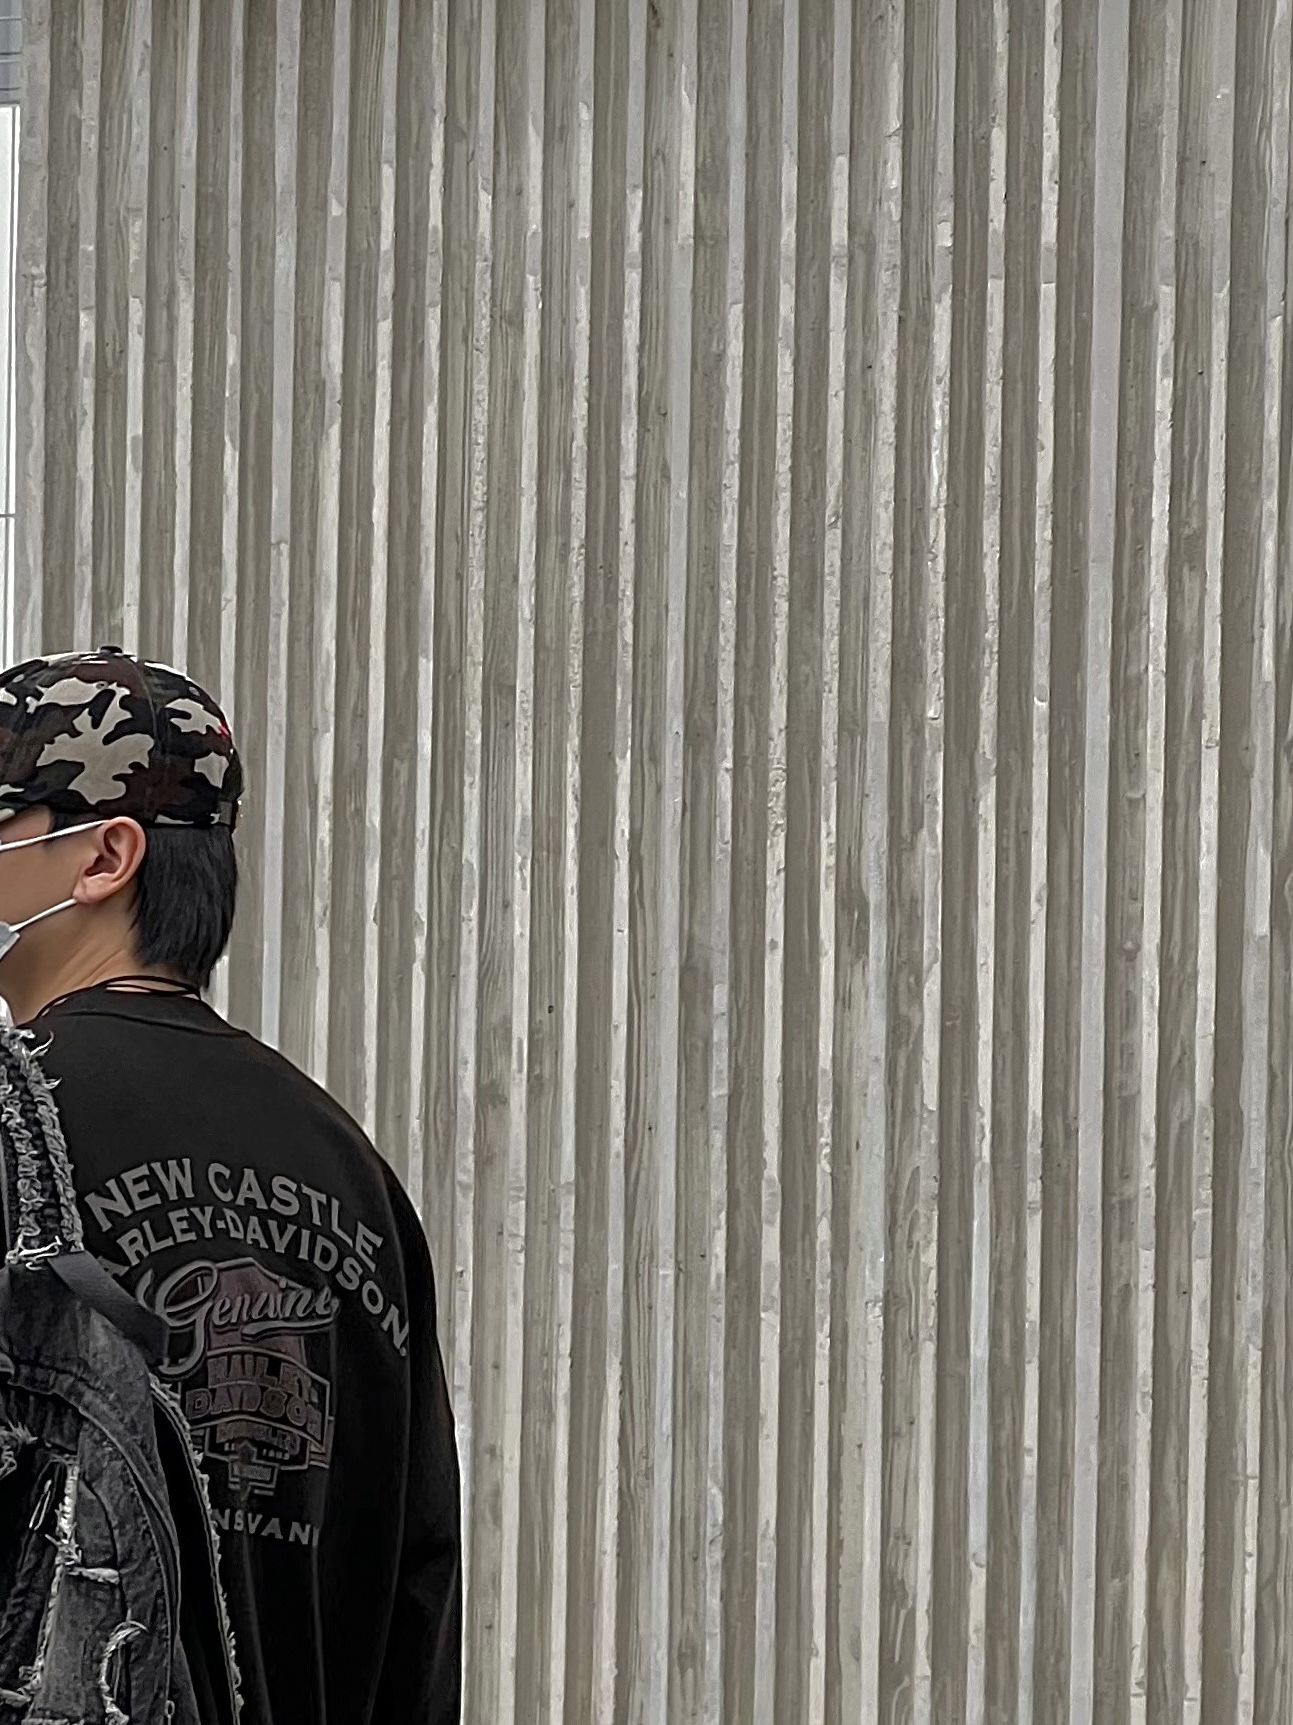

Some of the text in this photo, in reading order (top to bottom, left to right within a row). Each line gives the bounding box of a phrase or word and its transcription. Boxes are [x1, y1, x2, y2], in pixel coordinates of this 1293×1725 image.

[84, 1157, 384, 1273] NEW CASTLE
[136, 1258, 341, 1376] Genuine
